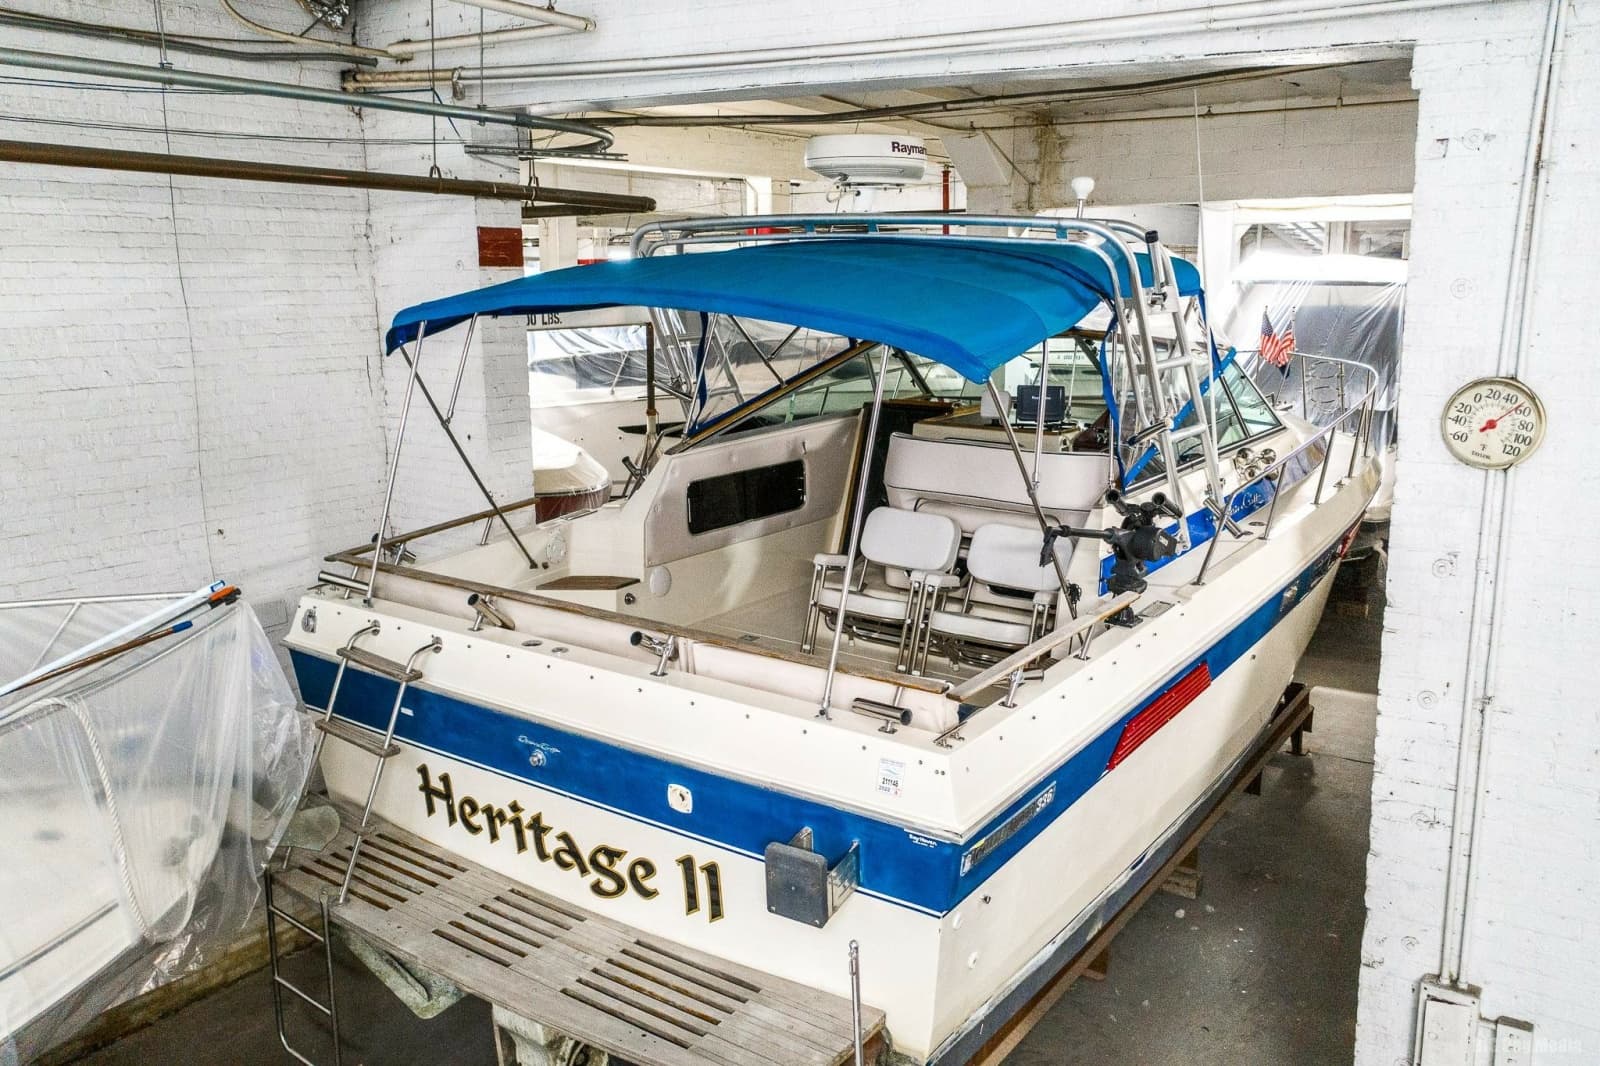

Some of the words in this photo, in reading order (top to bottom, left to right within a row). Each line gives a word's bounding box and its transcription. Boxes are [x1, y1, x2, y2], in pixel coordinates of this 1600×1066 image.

[1473, 392, 1482, 404] 0
[1485, 388, 1501, 401] 20
[1502, 393, 1519, 405] 40
[1454, 402, 1472, 415] -20
[1515, 405, 1531, 417] 60
[1448, 415, 1467, 427] -40
[1517, 420, 1534, 433] 80
[1449, 430, 1468, 443] -60
[1513, 433, 1532, 447] 100
[1502, 444, 1521, 457] 120
[416, 763, 660, 900] Heritage
